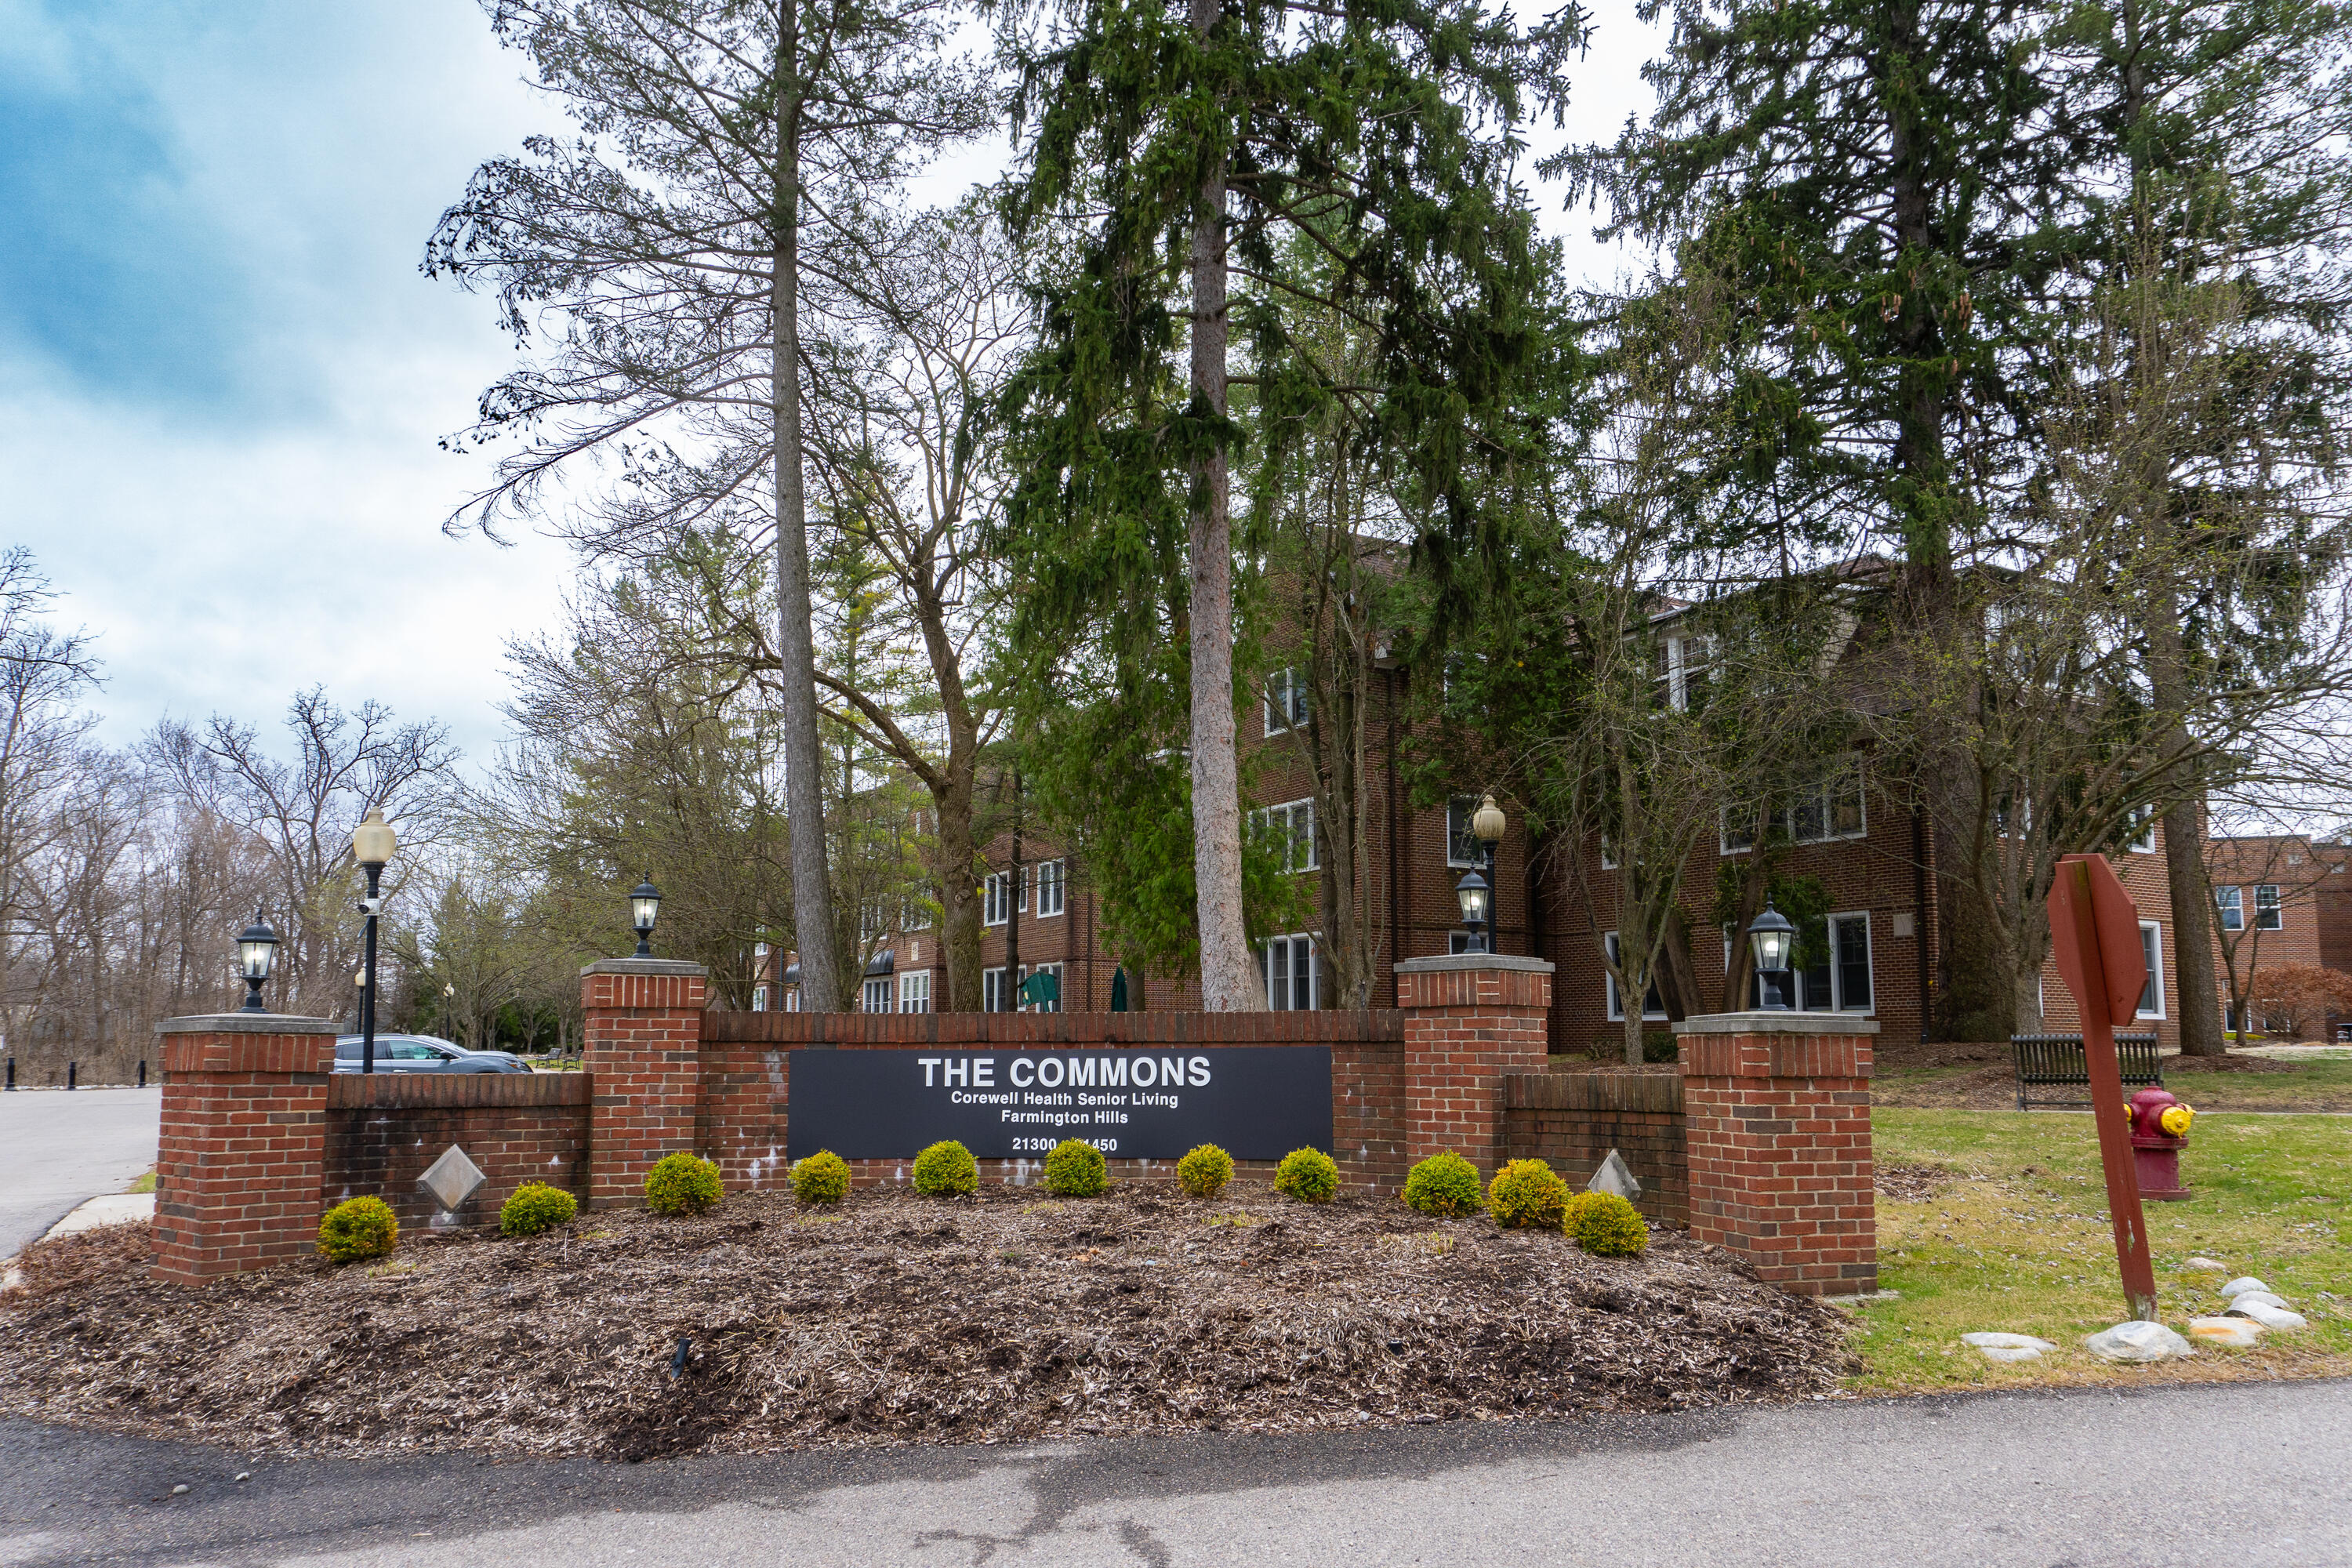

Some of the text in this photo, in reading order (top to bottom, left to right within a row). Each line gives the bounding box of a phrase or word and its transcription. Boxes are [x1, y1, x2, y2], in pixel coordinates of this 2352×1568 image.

[918, 1056, 1211, 1087] THE COMMONS
[951, 1091, 1178, 1109] Corewell Health Senior Living
[1001, 1109, 1128, 1127] Farmington Hills
[1012, 1137, 1117, 1152] 21300 1450
